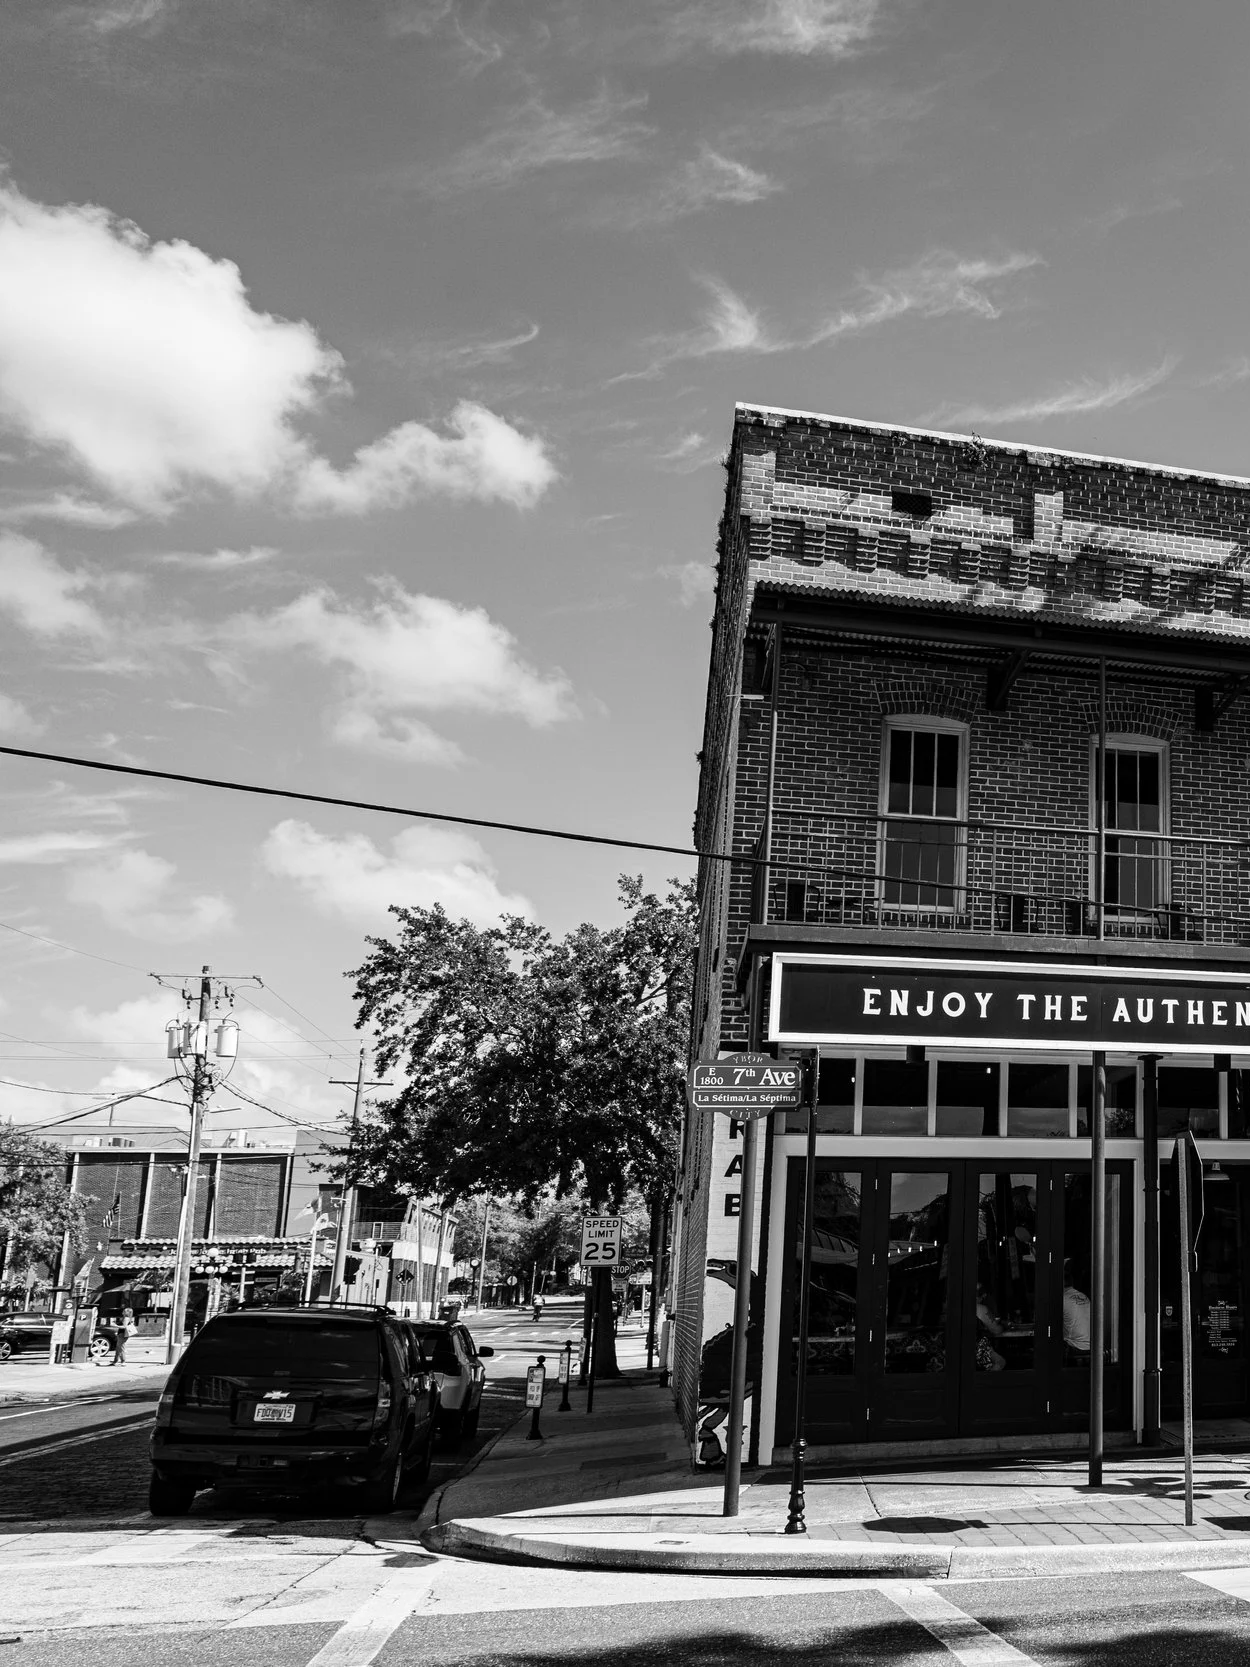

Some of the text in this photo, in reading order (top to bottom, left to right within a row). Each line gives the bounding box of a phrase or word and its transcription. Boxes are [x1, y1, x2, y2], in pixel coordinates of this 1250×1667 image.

[862, 987, 993, 1019] ENJOY
[1016, 994, 1088, 1021] THE
[732, 1055, 763, 1064] YBOR
[708, 1067, 716, 1076] E
[700, 1076, 724, 1085] 1800
[733, 1068, 796, 1086] 7th Ave
[698, 1093, 796, 1103] La Sétima/La Séptima
[729, 1109, 761, 1118] CITY
[585, 1220, 619, 1228] SPEED
[588, 1230, 615, 1238] LIMIT
[584, 1242, 616, 1260] 25
[611, 1265, 630, 1274] STOP
